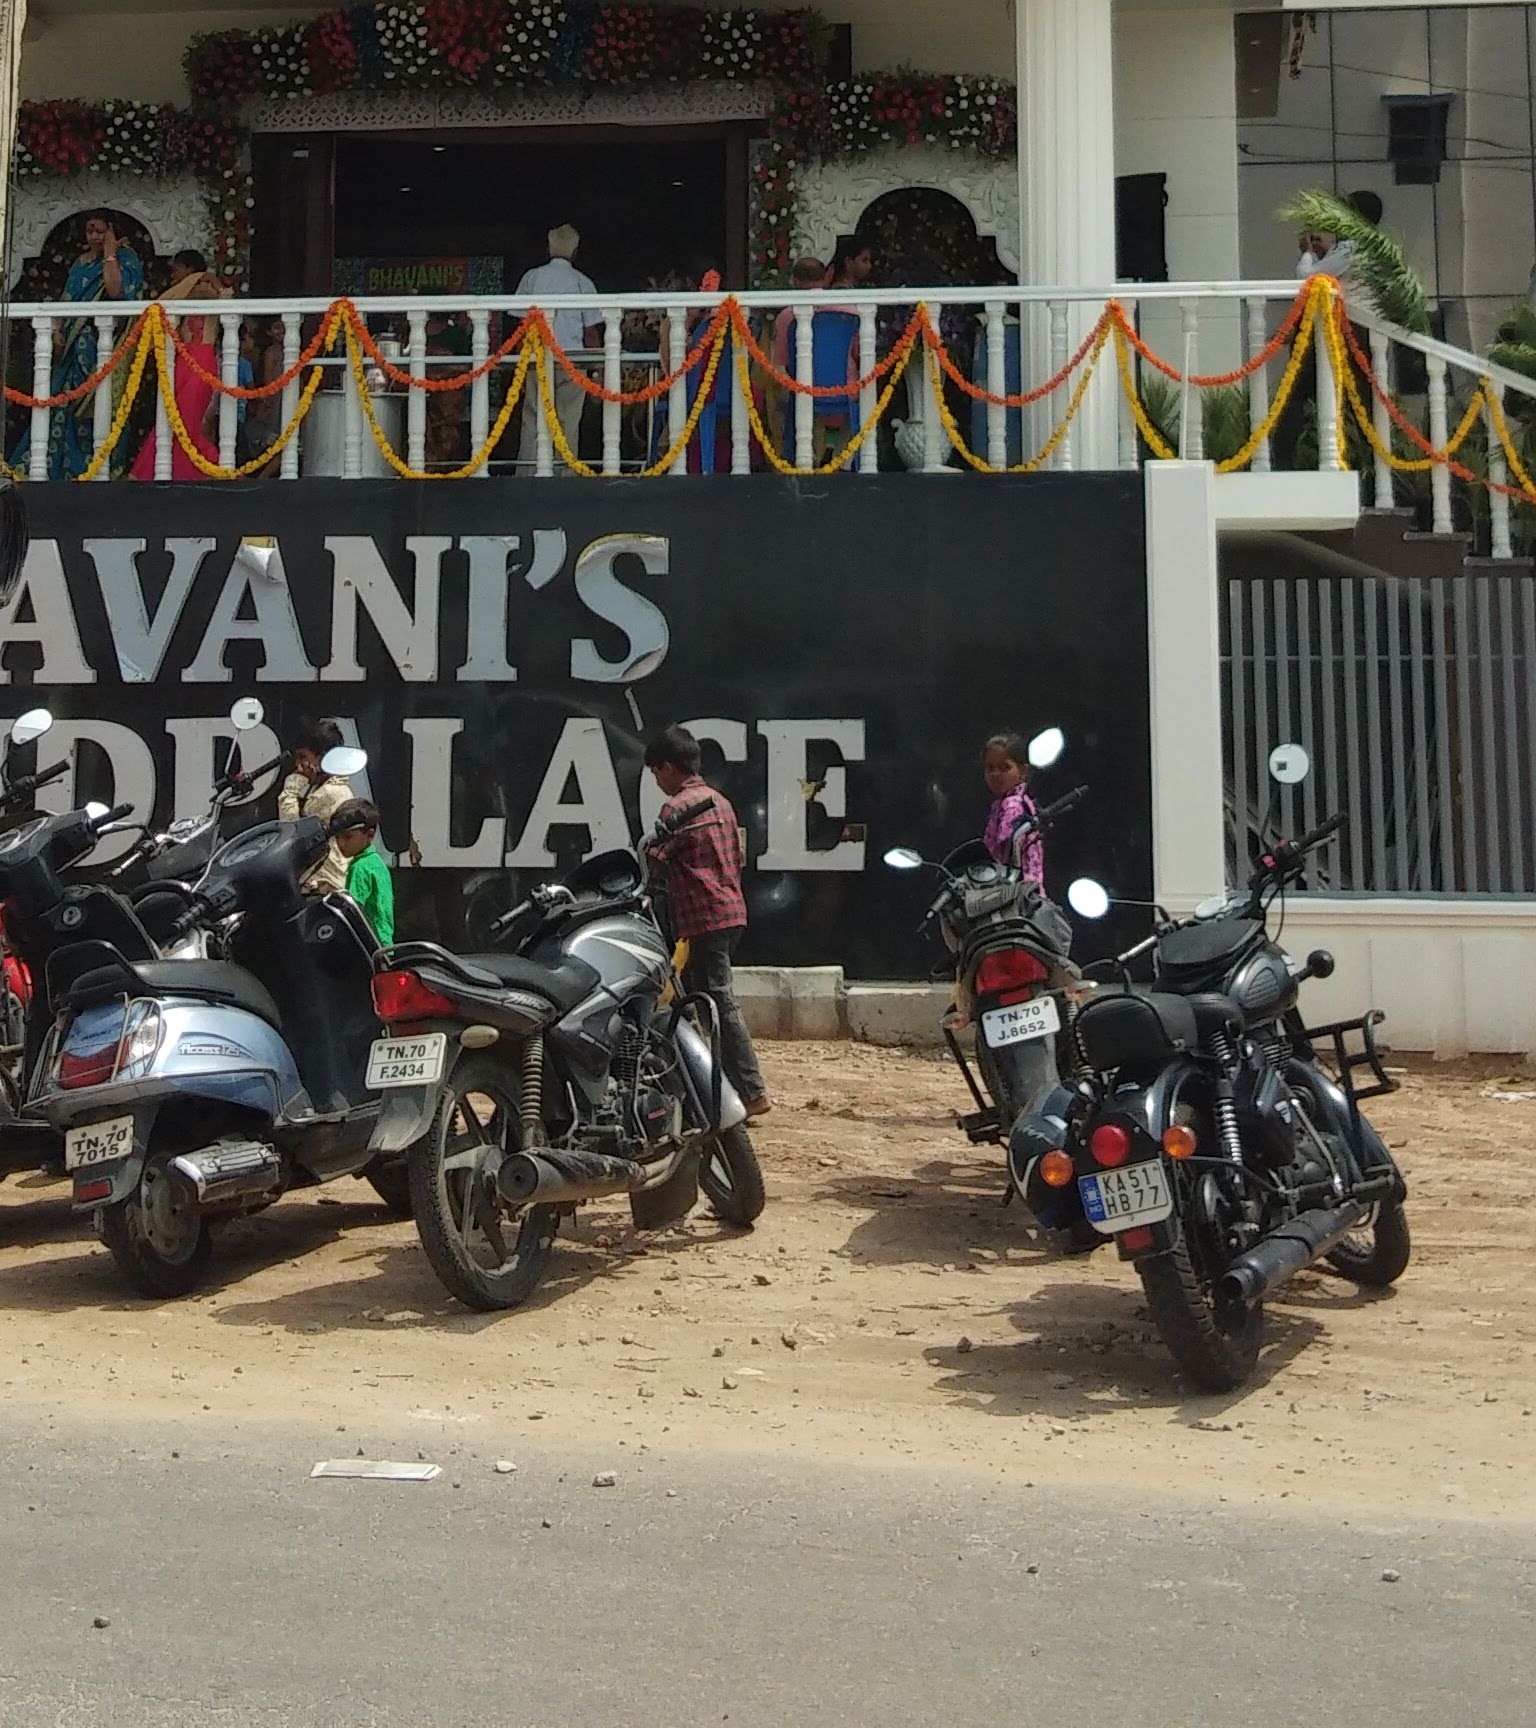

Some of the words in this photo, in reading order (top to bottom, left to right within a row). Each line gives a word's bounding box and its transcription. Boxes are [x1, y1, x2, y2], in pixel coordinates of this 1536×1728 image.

[997, 1005, 1041, 1025] TN.70
[997, 1020, 1047, 1041] J.8652
[386, 1044, 427, 1060] TN.70
[379, 1063, 425, 1079] F.2434
[72, 1127, 128, 1152] TN.70
[75, 1143, 120, 1165] 7015
